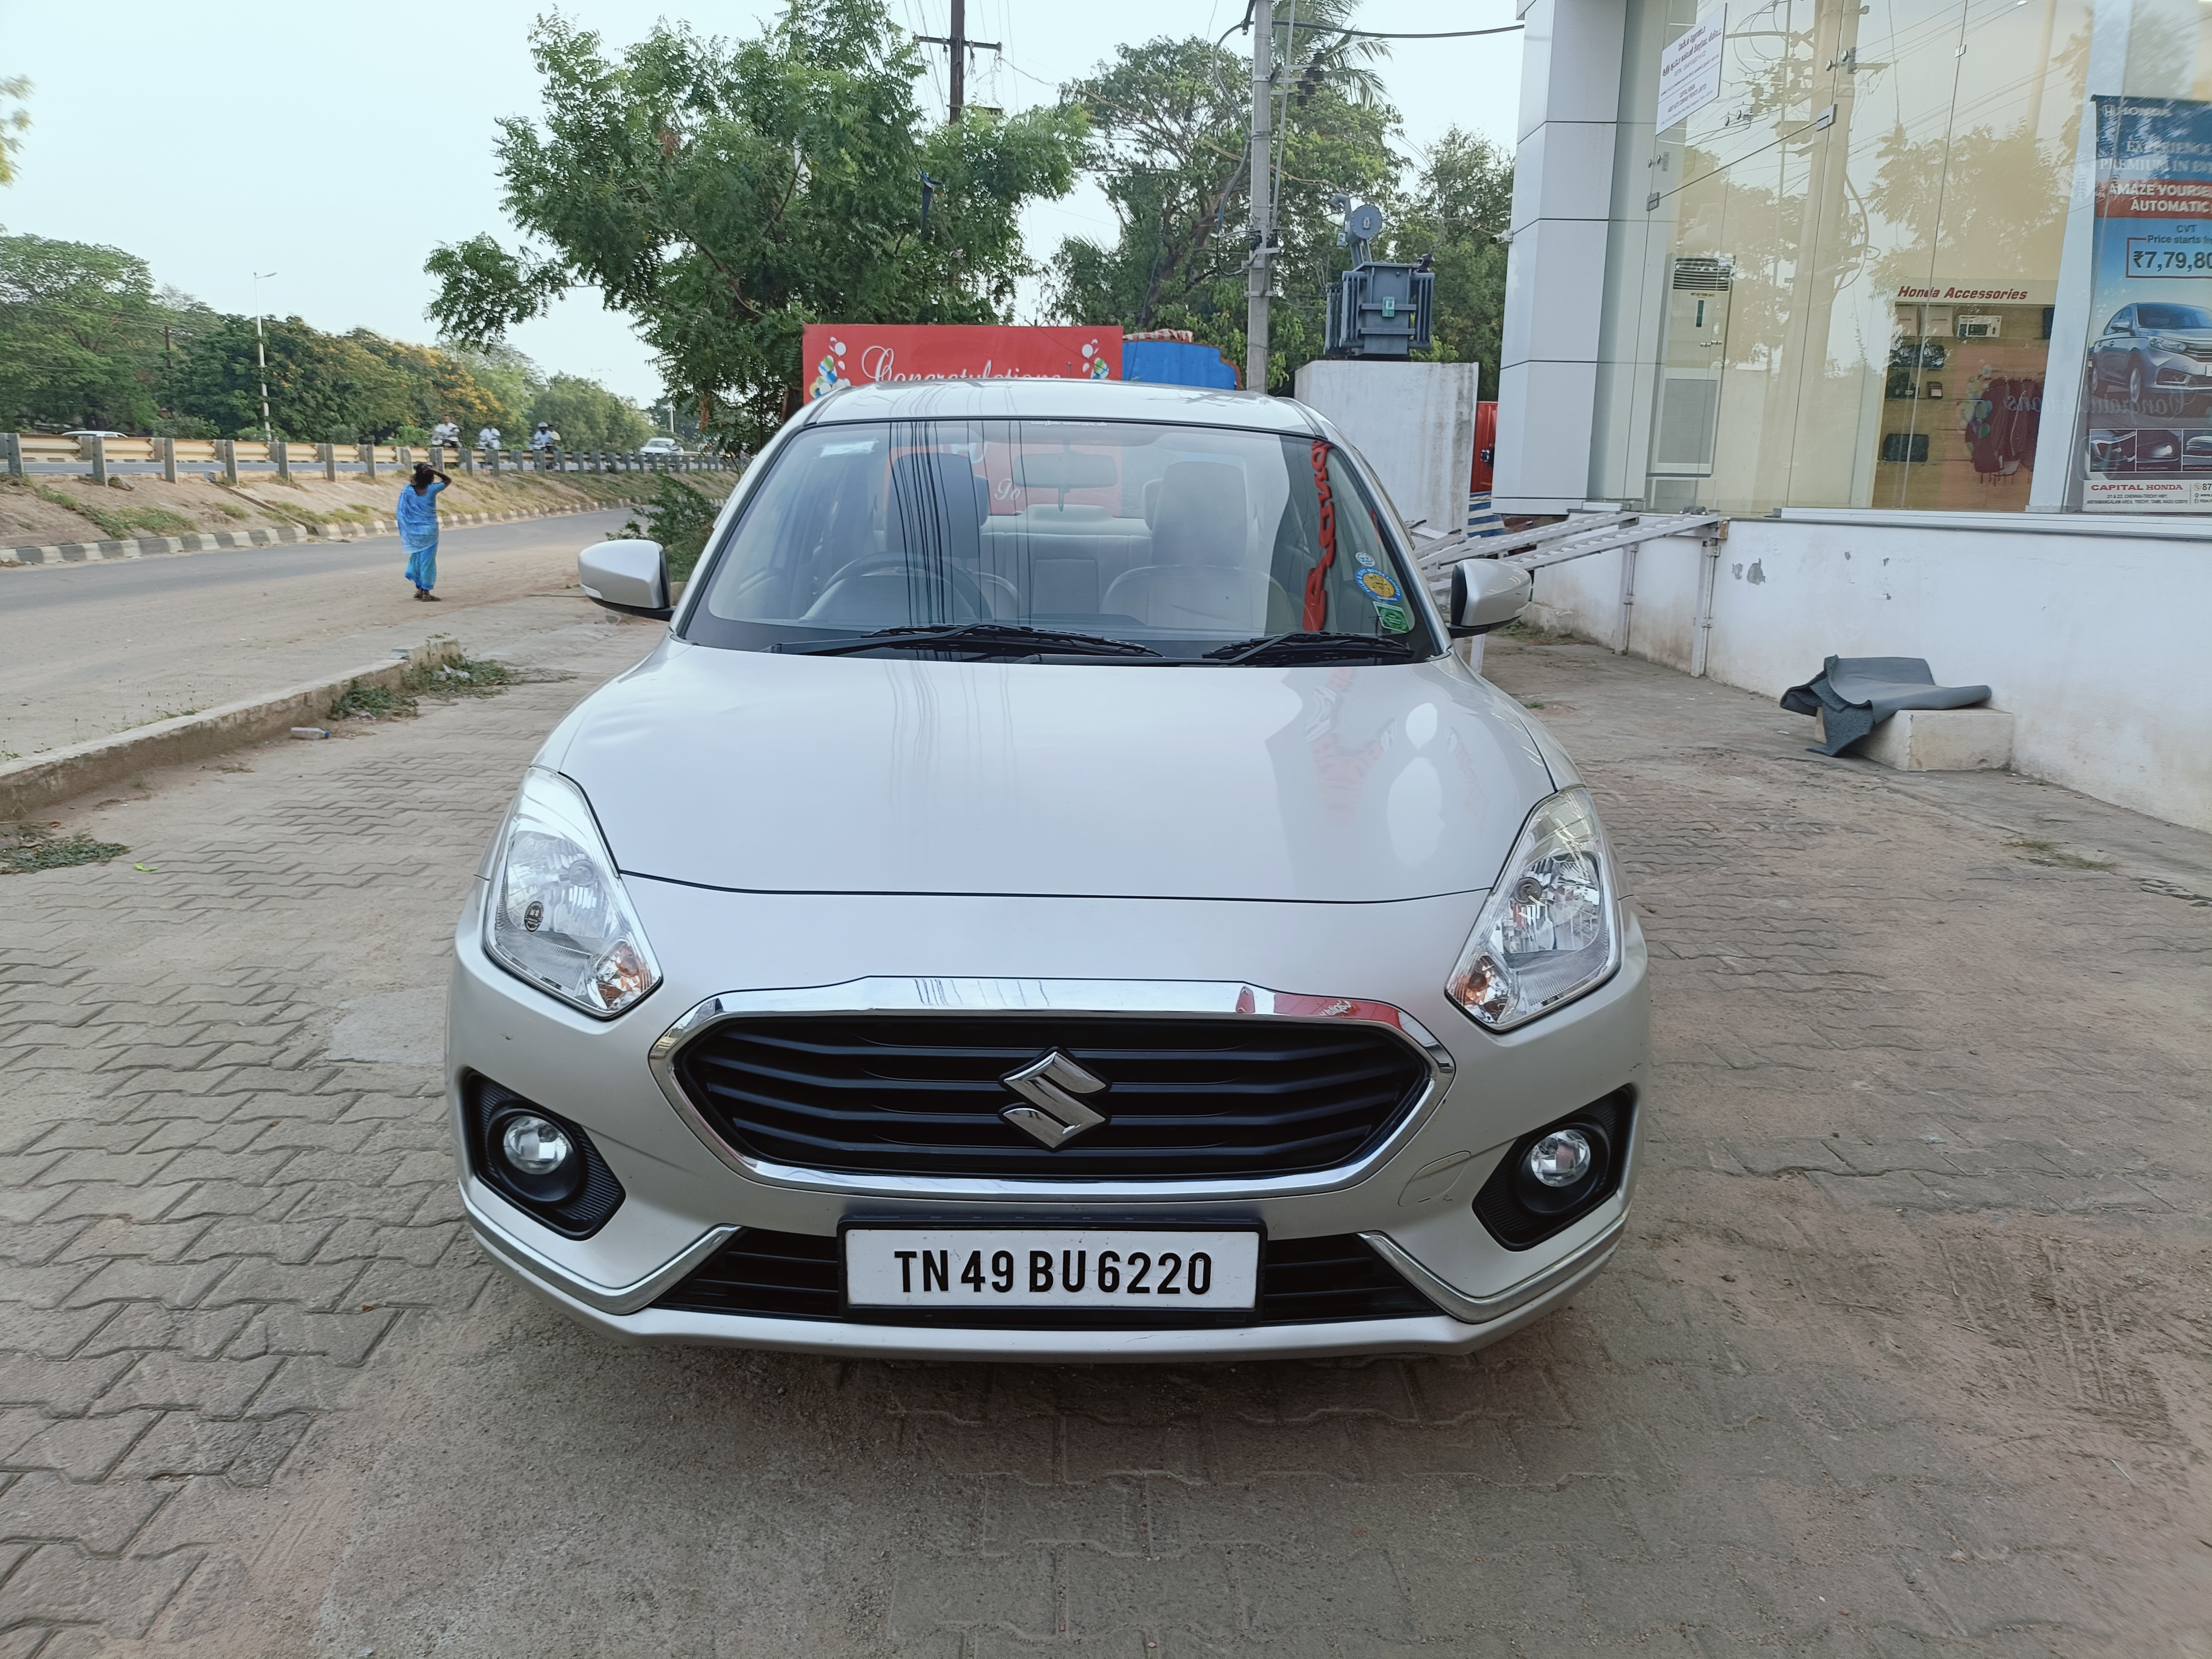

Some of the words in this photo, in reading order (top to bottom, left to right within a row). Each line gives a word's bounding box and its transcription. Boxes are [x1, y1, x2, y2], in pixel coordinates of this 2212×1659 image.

[2110, 183, 2155, 196] AMAZE
[2176, 224, 2198, 233] CVT
[2147, 235, 2171, 243] Price
[2174, 235, 2201, 243] starts
[1898, 286, 1939, 299] Honda
[1944, 287, 2028, 300] Accessories
[894, 1250, 949, 1293] TN
[961, 1250, 1014, 1293] 49
[1029, 1250, 1086, 1293] BU
[1098, 1251, 1212, 1294] 6220
